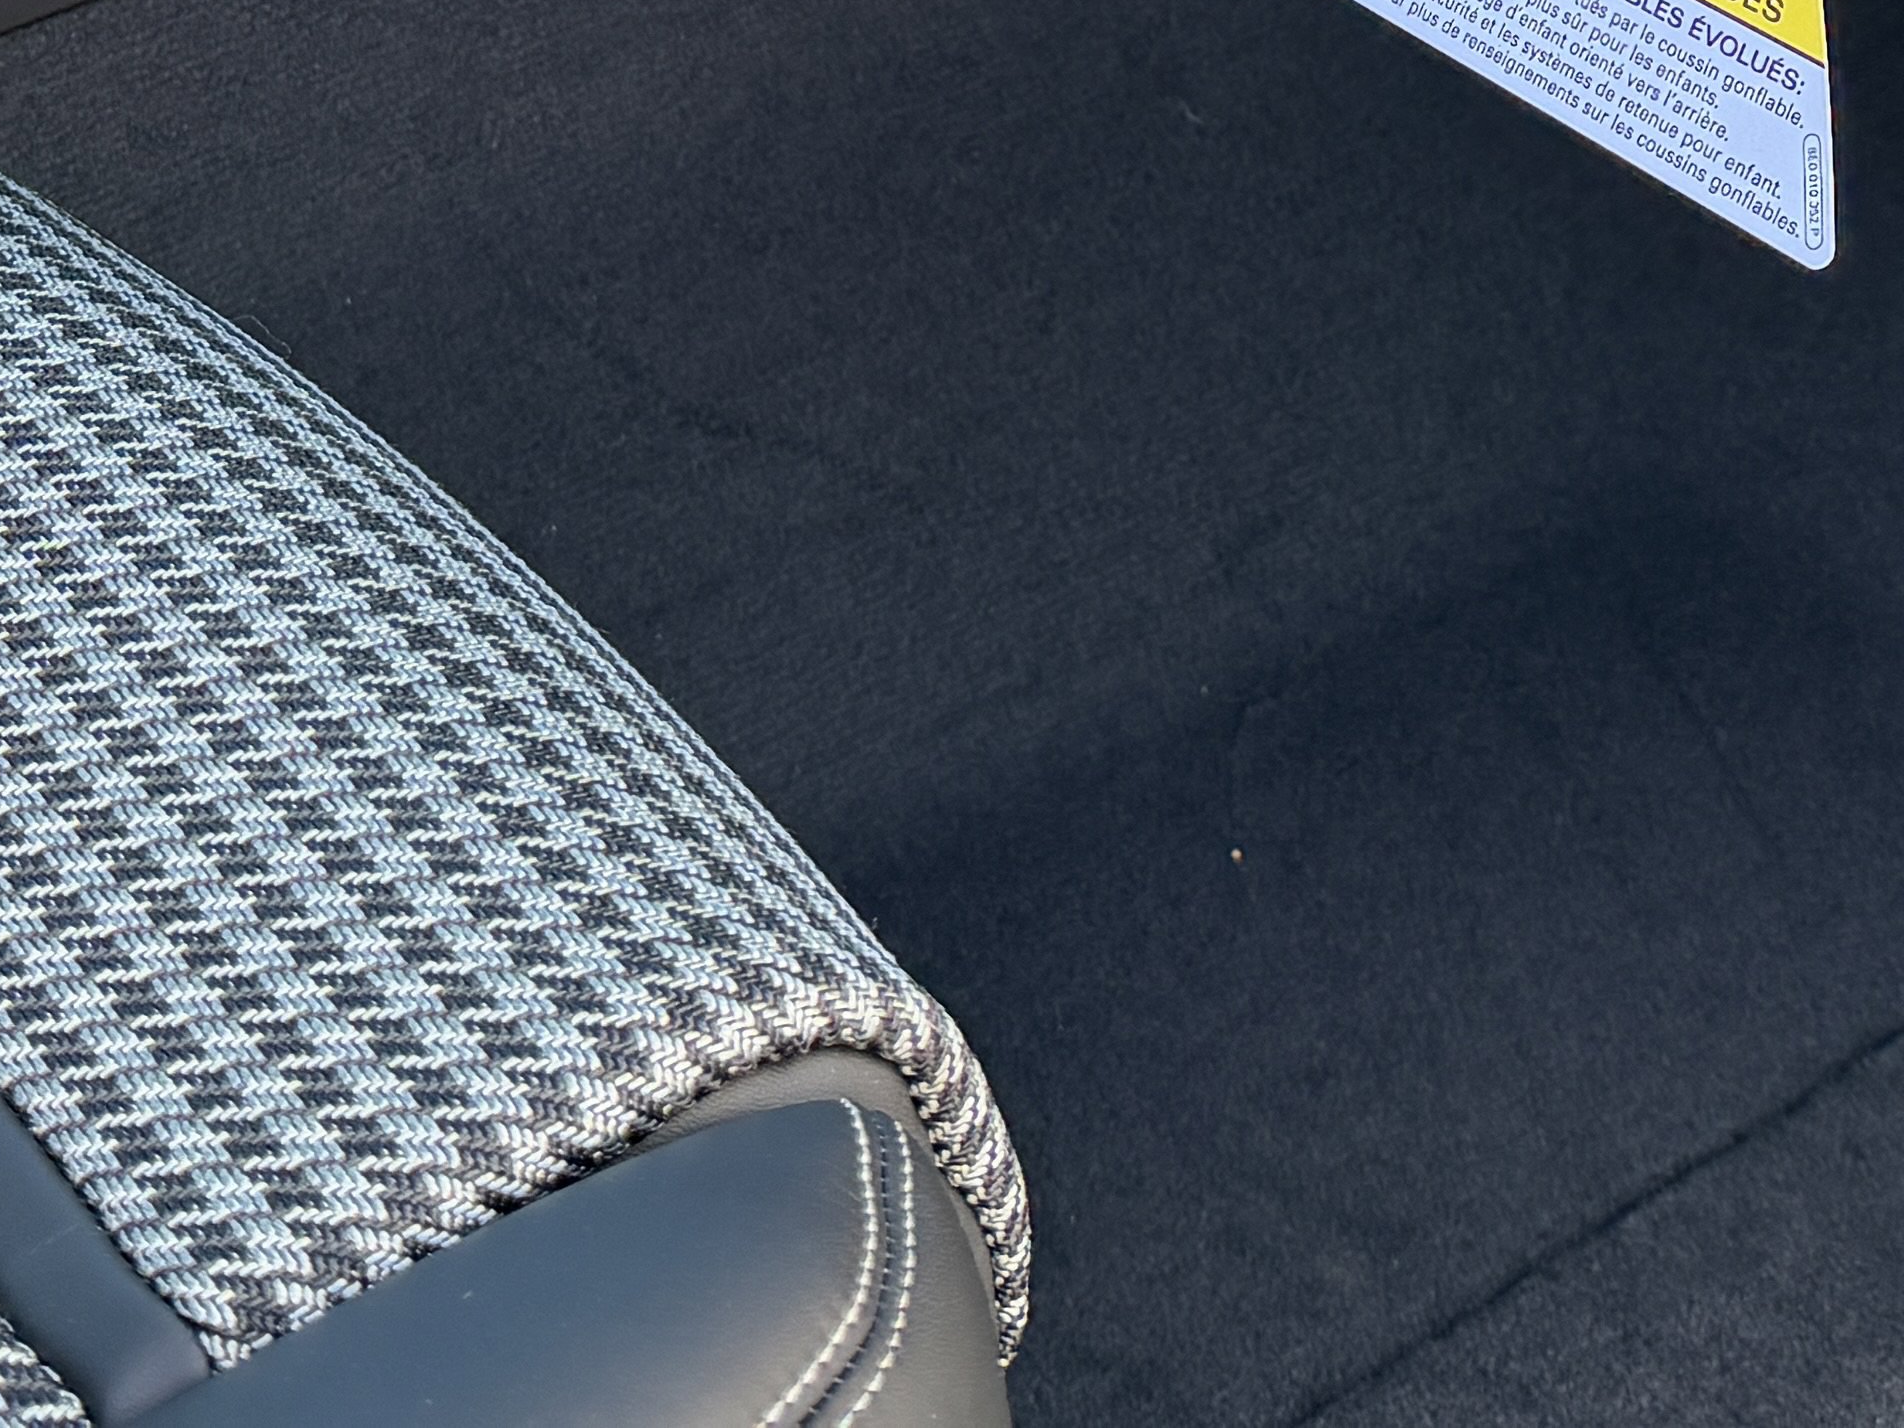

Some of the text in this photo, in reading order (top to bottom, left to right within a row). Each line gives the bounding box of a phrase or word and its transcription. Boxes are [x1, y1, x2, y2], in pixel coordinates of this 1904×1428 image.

[1587, 26, 1628, 55] pour
[1628, 44, 1653, 70] les
[1608, 11, 1638, 34] par
[1639, 23, 1655, 44] le
[1657, 38, 1719, 80] coussin
[1687, 15, 1805, 95] ÉVOLUÉS:
[1406, 1, 1439, 27] plus
[1441, 18, 1460, 38] de
[1581, 101, 1609, 124] sur
[1609, 113, 1634, 140] les
[1636, 133, 1707, 182] coussins
[1480, 17, 1496, 34] et
[1496, 22, 1519, 47] les
[1594, 80, 1615, 102] de
[1617, 95, 1678, 138] retenue
[1680, 131, 1723, 162] pour
[1627, 72, 1660, 101] vers
